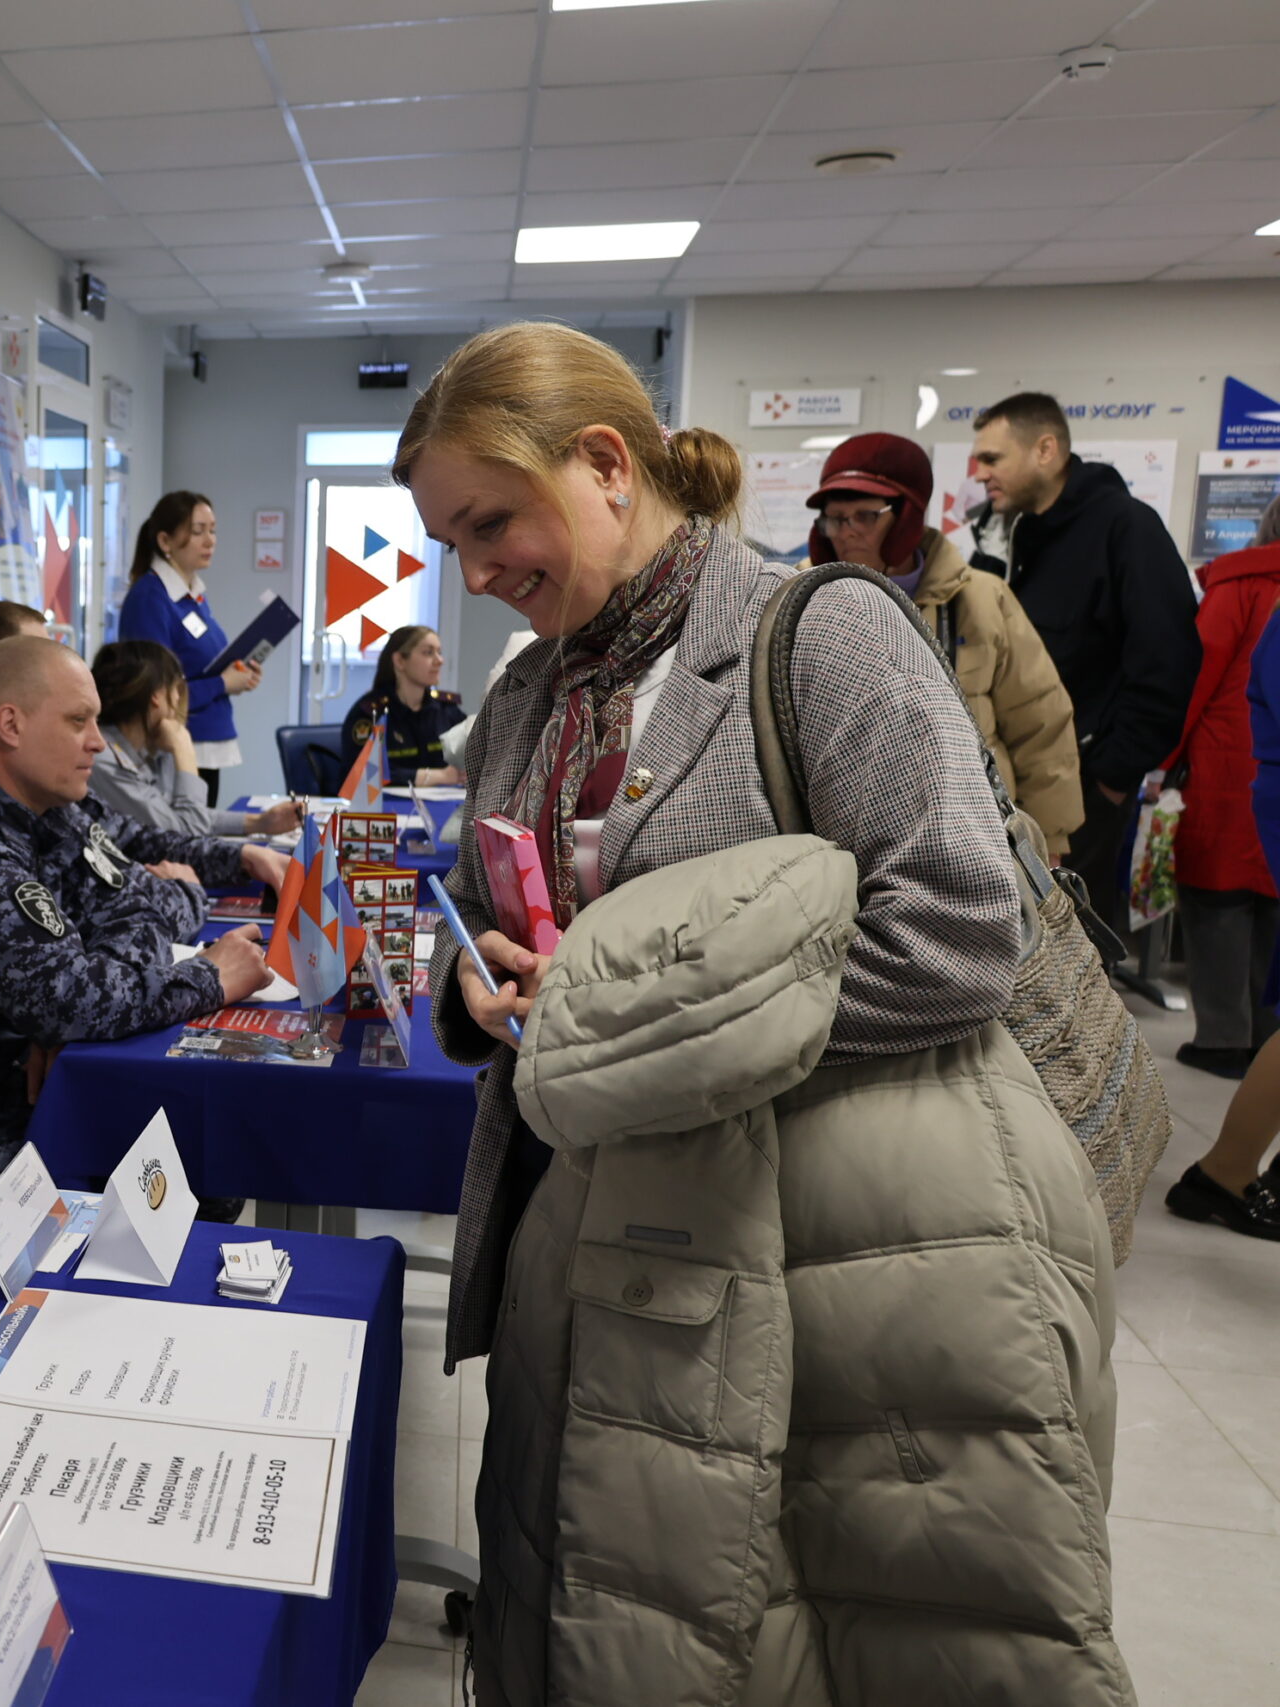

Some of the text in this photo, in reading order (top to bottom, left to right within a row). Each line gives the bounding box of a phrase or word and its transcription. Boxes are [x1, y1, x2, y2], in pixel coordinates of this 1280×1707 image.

[798, 396, 841, 404] РАБОТА
[798, 406, 841, 415] РОССИИ
[1090, 403, 1156, 419] УСЛУГ
[947, 405, 977, 421] ОТ
[34, 1363, 58, 1390] Грузчик
[69, 1369, 91, 1395] Пекарь
[103, 1361, 130, 1399] Упаковщик
[139, 1336, 175, 1403] Формовщик ручной
[157, 1369, 179, 1405] формовки
[13, 1426, 36, 1459] хлебный
[30, 1412, 43, 1426] цех
[19, 1452, 48, 1495] требуются:
[111, 1457, 127, 1472] 000р
[189, 1466, 204, 1482] 000р
[49, 1458, 80, 1497] Пекаря
[104, 1472, 120, 1490] 50-60
[119, 1462, 151, 1511] Грузчики
[73, 1478, 90, 1503] Обучение
[104, 1490, 112, 1498] от
[146, 1456, 184, 1525] Кладовщики
[184, 1482, 198, 1500] 45-55
[252, 1459, 286, 1545] 8-913-410-05-10
[183, 1500, 192, 1508] от
